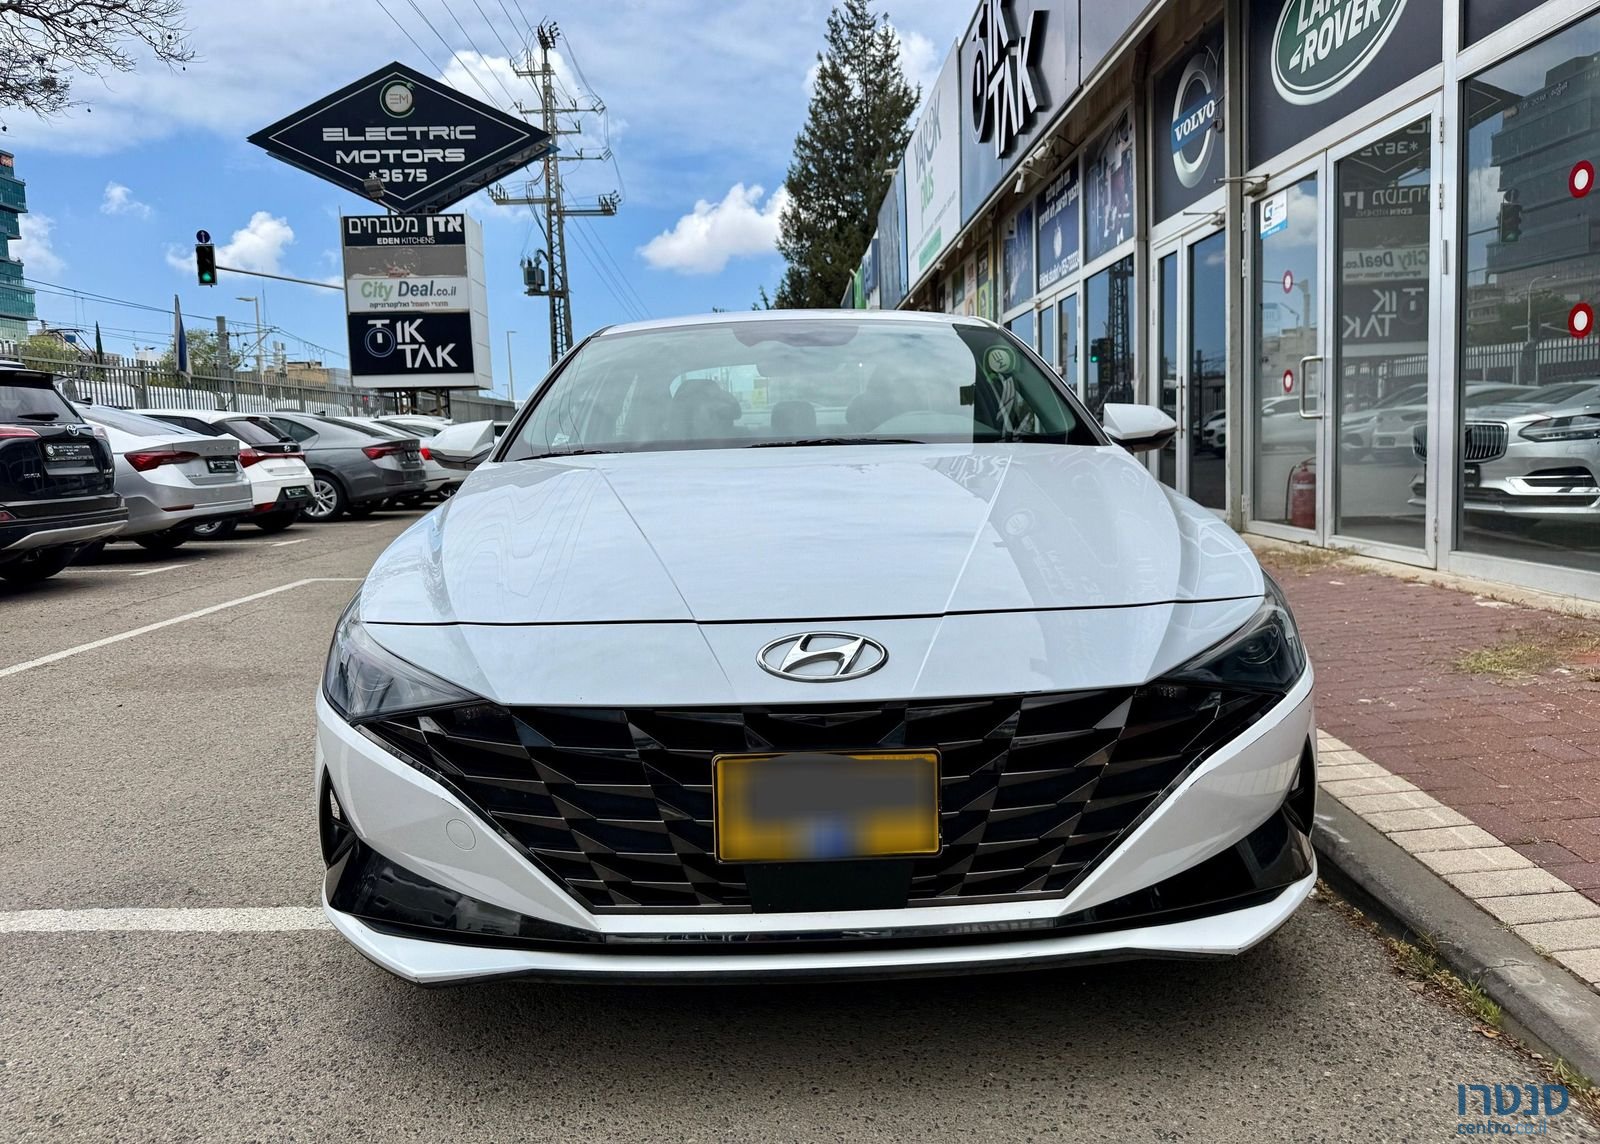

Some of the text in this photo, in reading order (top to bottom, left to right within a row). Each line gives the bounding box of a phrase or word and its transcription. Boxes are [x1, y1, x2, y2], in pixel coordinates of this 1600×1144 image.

[1296, 0, 1341, 36] LA
[988, 10, 1040, 159] TAK
[1174, 99, 1215, 142] VOLVO
[335, 148, 466, 164] MOTORS
[348, 216, 463, 236] אדן מטבחים
[377, 236, 435, 245] EDEN KITCHENS
[361, 280, 457, 301] City Deal.co.il
[367, 318, 426, 344] TIK
[396, 343, 458, 368] TAK
